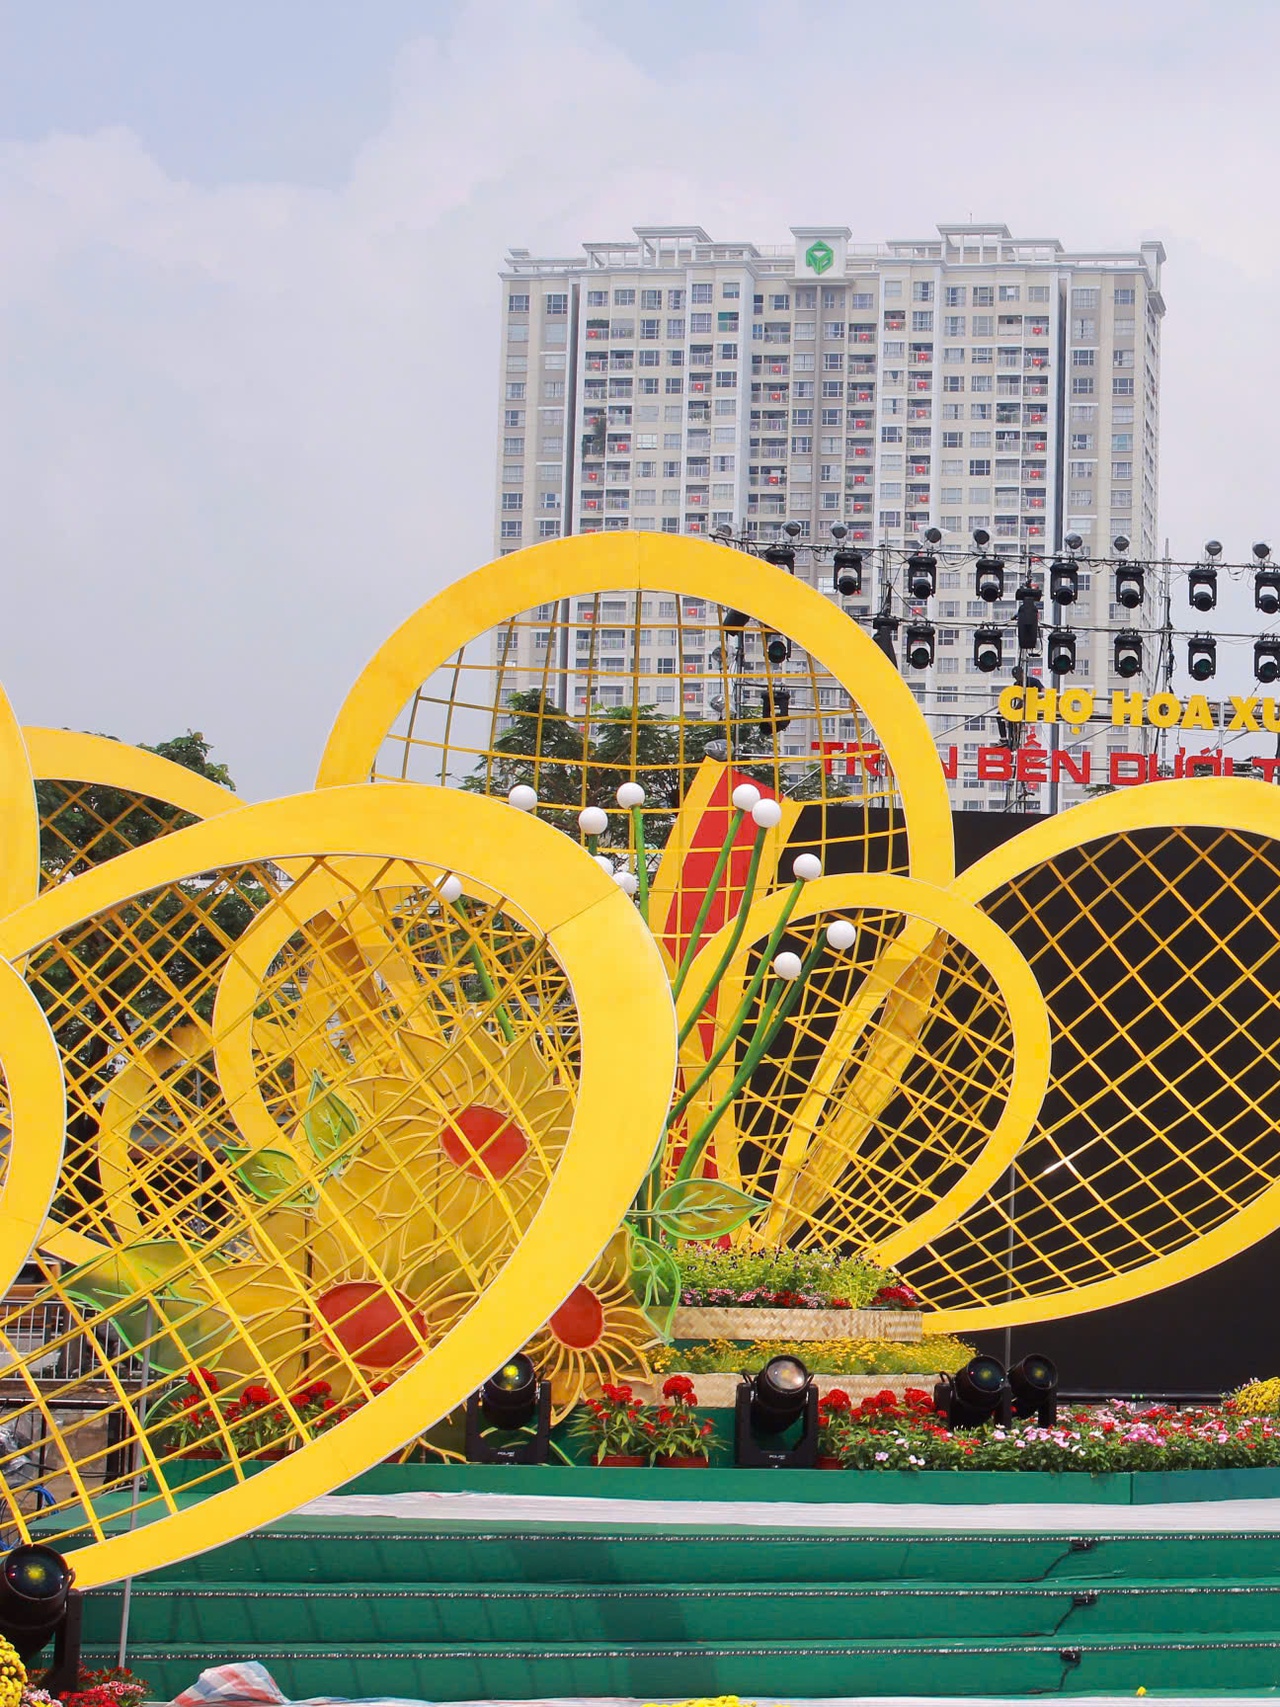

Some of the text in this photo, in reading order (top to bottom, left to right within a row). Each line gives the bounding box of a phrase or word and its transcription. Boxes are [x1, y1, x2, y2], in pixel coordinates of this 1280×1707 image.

[998, 685, 1097, 735] CHỢ
[1112, 690, 1215, 730] HOA
[978, 732, 1091, 785] BẾN
[1110, 746, 1234, 785] DƯỚI
